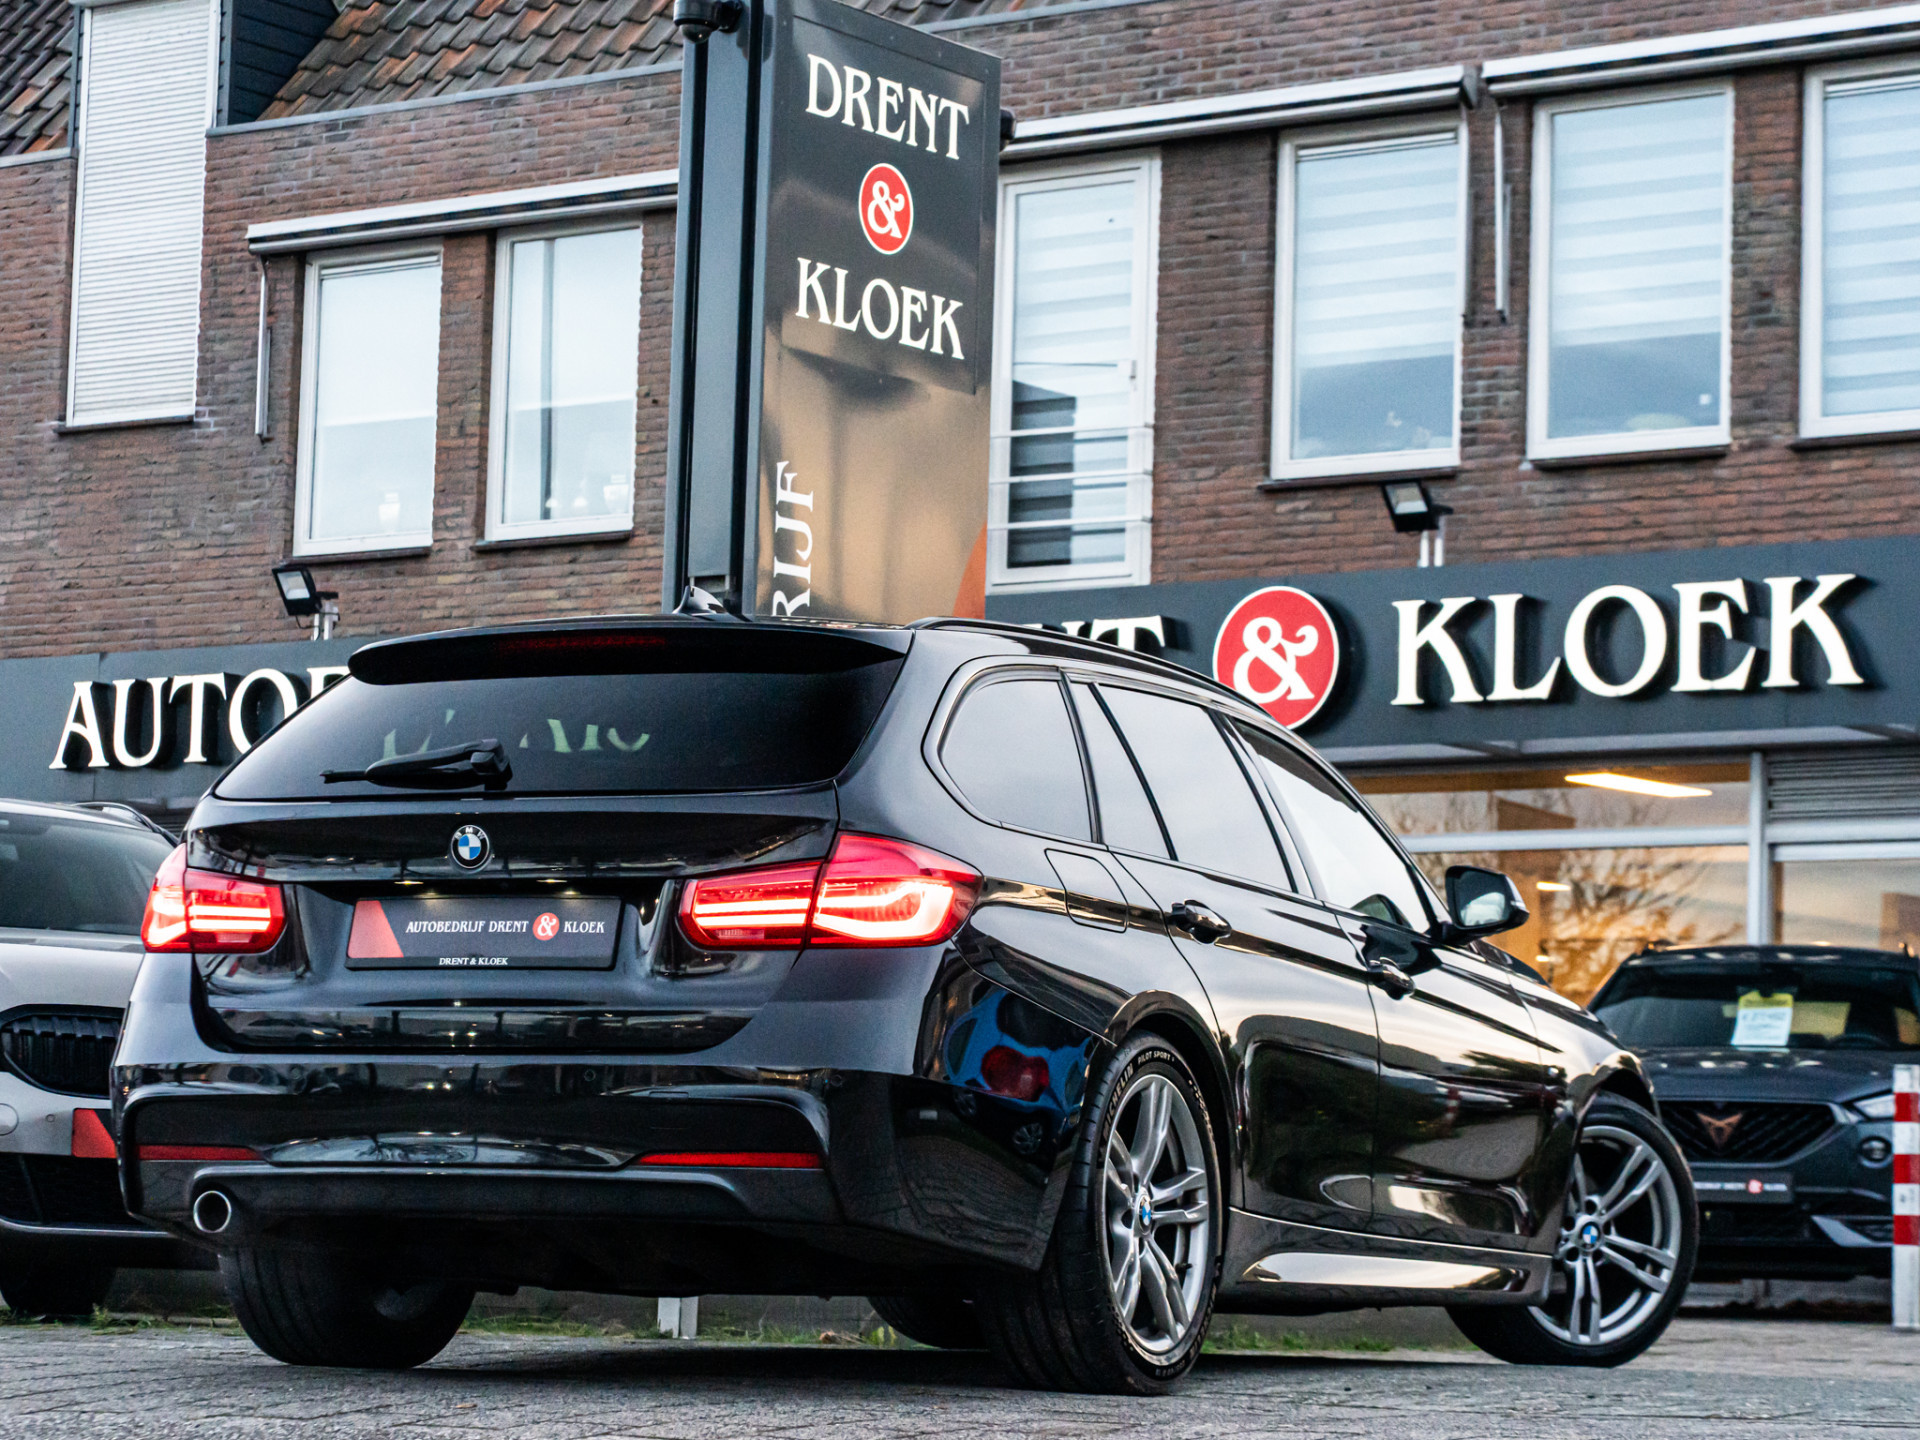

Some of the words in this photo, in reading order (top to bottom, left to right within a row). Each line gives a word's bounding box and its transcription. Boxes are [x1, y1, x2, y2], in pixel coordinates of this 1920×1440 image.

[806, 53, 970, 160] DRENT
[867, 180, 906, 239] &
[795, 256, 965, 360] KLOEK
[1232, 616, 1319, 704] &
[1391, 573, 1865, 706] KLOEK
[405, 920, 486, 933] AUTOBEDRIJF
[488, 920, 529, 933] DRENT
[563, 921, 605, 934] KLOEK
[438, 957, 469, 966] DRENT
[469, 957, 477, 966] &
[478, 957, 508, 966] KLOEK
[1137, 1051, 1153, 1064] PILOT
[1153, 1050, 1171, 1061] SPORT
